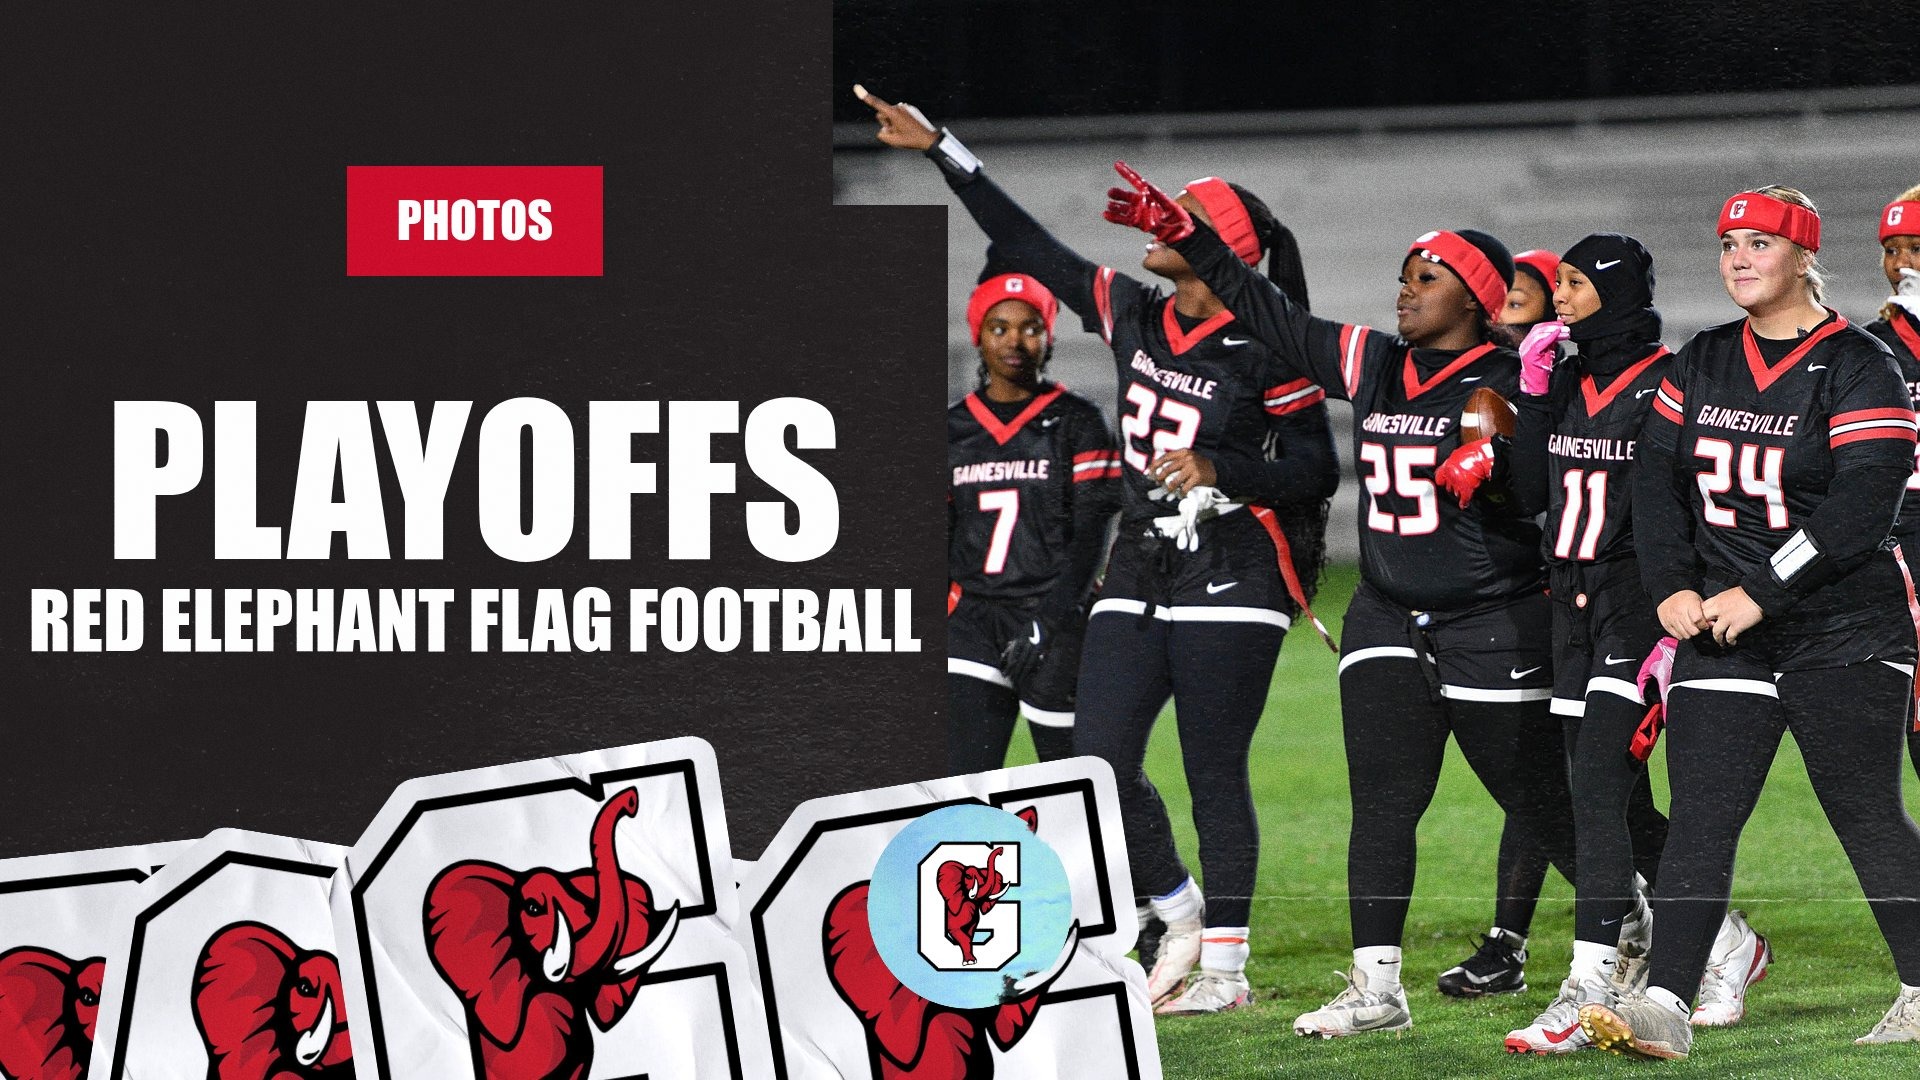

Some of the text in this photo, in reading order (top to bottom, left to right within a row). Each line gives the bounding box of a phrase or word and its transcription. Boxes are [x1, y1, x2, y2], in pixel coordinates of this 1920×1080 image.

[1121, 381, 1202, 475] 22
[1548, 433, 1637, 461] GAINESVILLE
[1696, 404, 1799, 436] GAINESVILLE
[952, 459, 1050, 486] GAINESVILLE
[1360, 441, 1440, 536] 25
[1554, 468, 1608, 561] 11
[1693, 436, 1790, 530] 24
[978, 487, 1019, 576] 7
